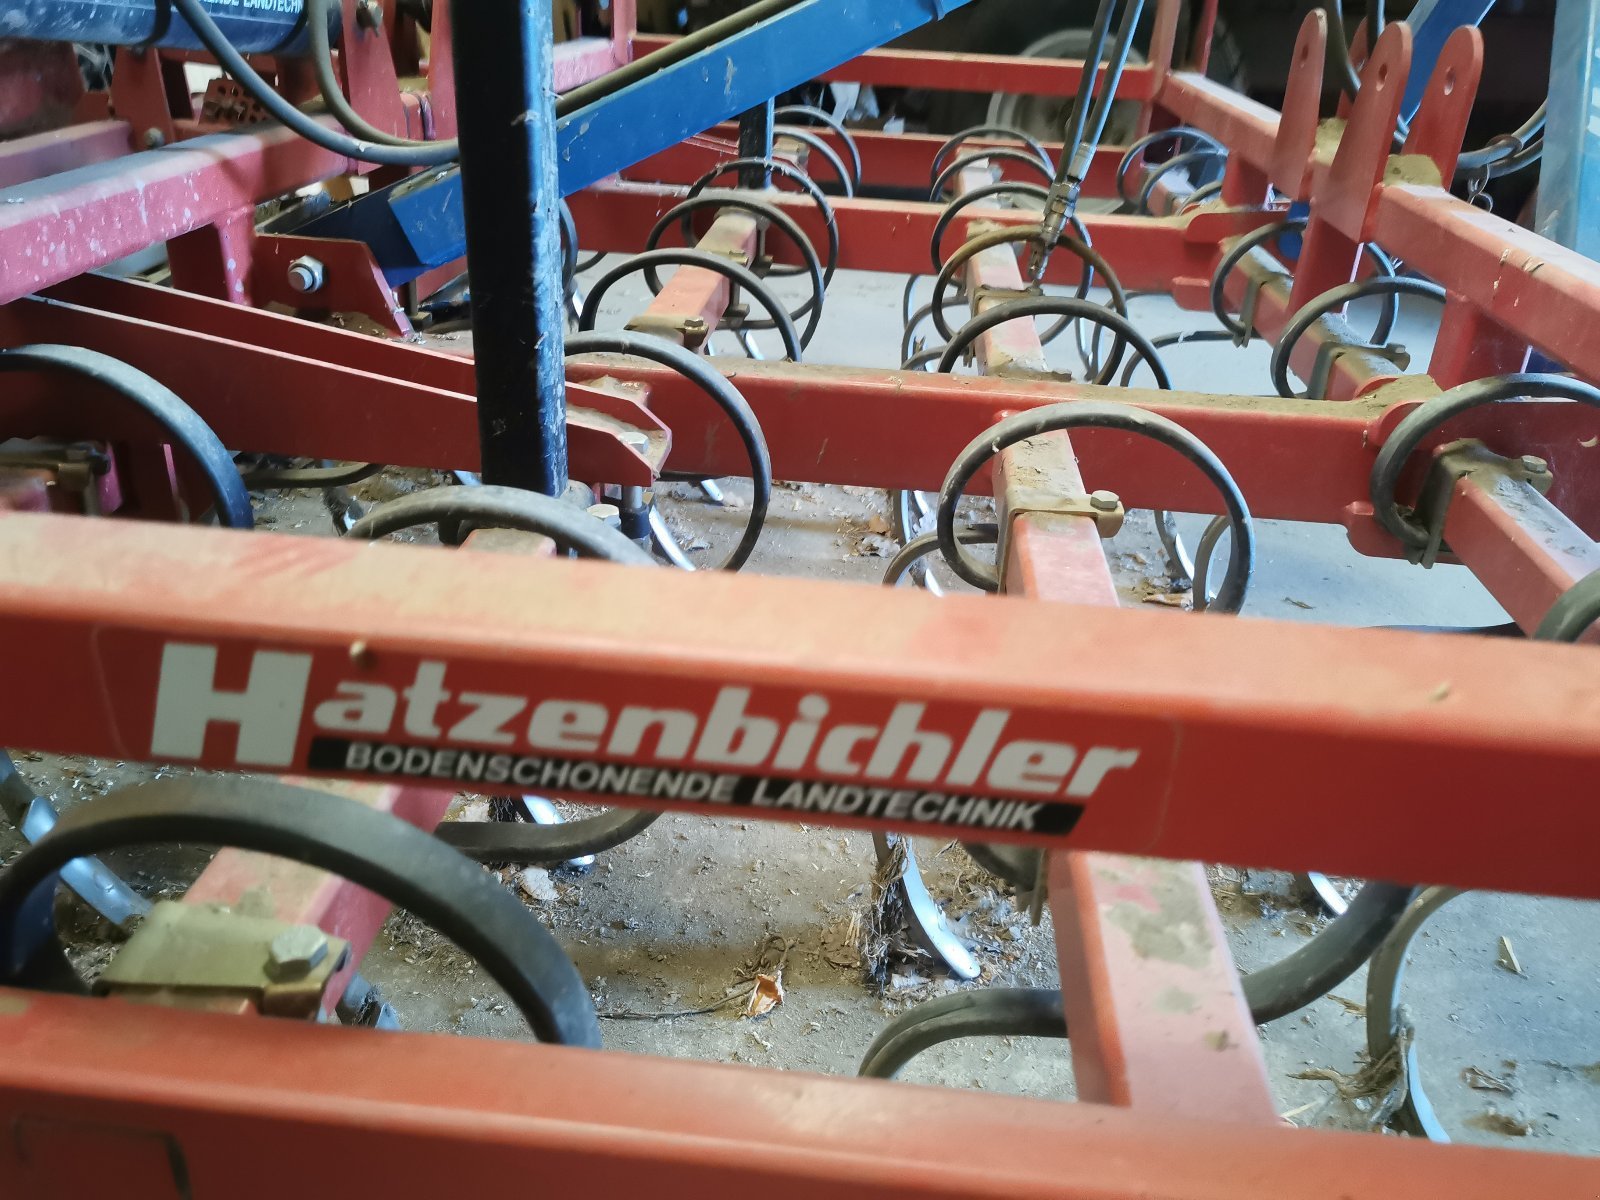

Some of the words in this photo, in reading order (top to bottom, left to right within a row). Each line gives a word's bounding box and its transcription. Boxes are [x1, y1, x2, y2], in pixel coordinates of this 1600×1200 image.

[151, 643, 1139, 797] Hatzenbichler
[345, 742, 740, 802] BODENSCHONENDE
[753, 780, 1043, 830] LANDTECHNIK
